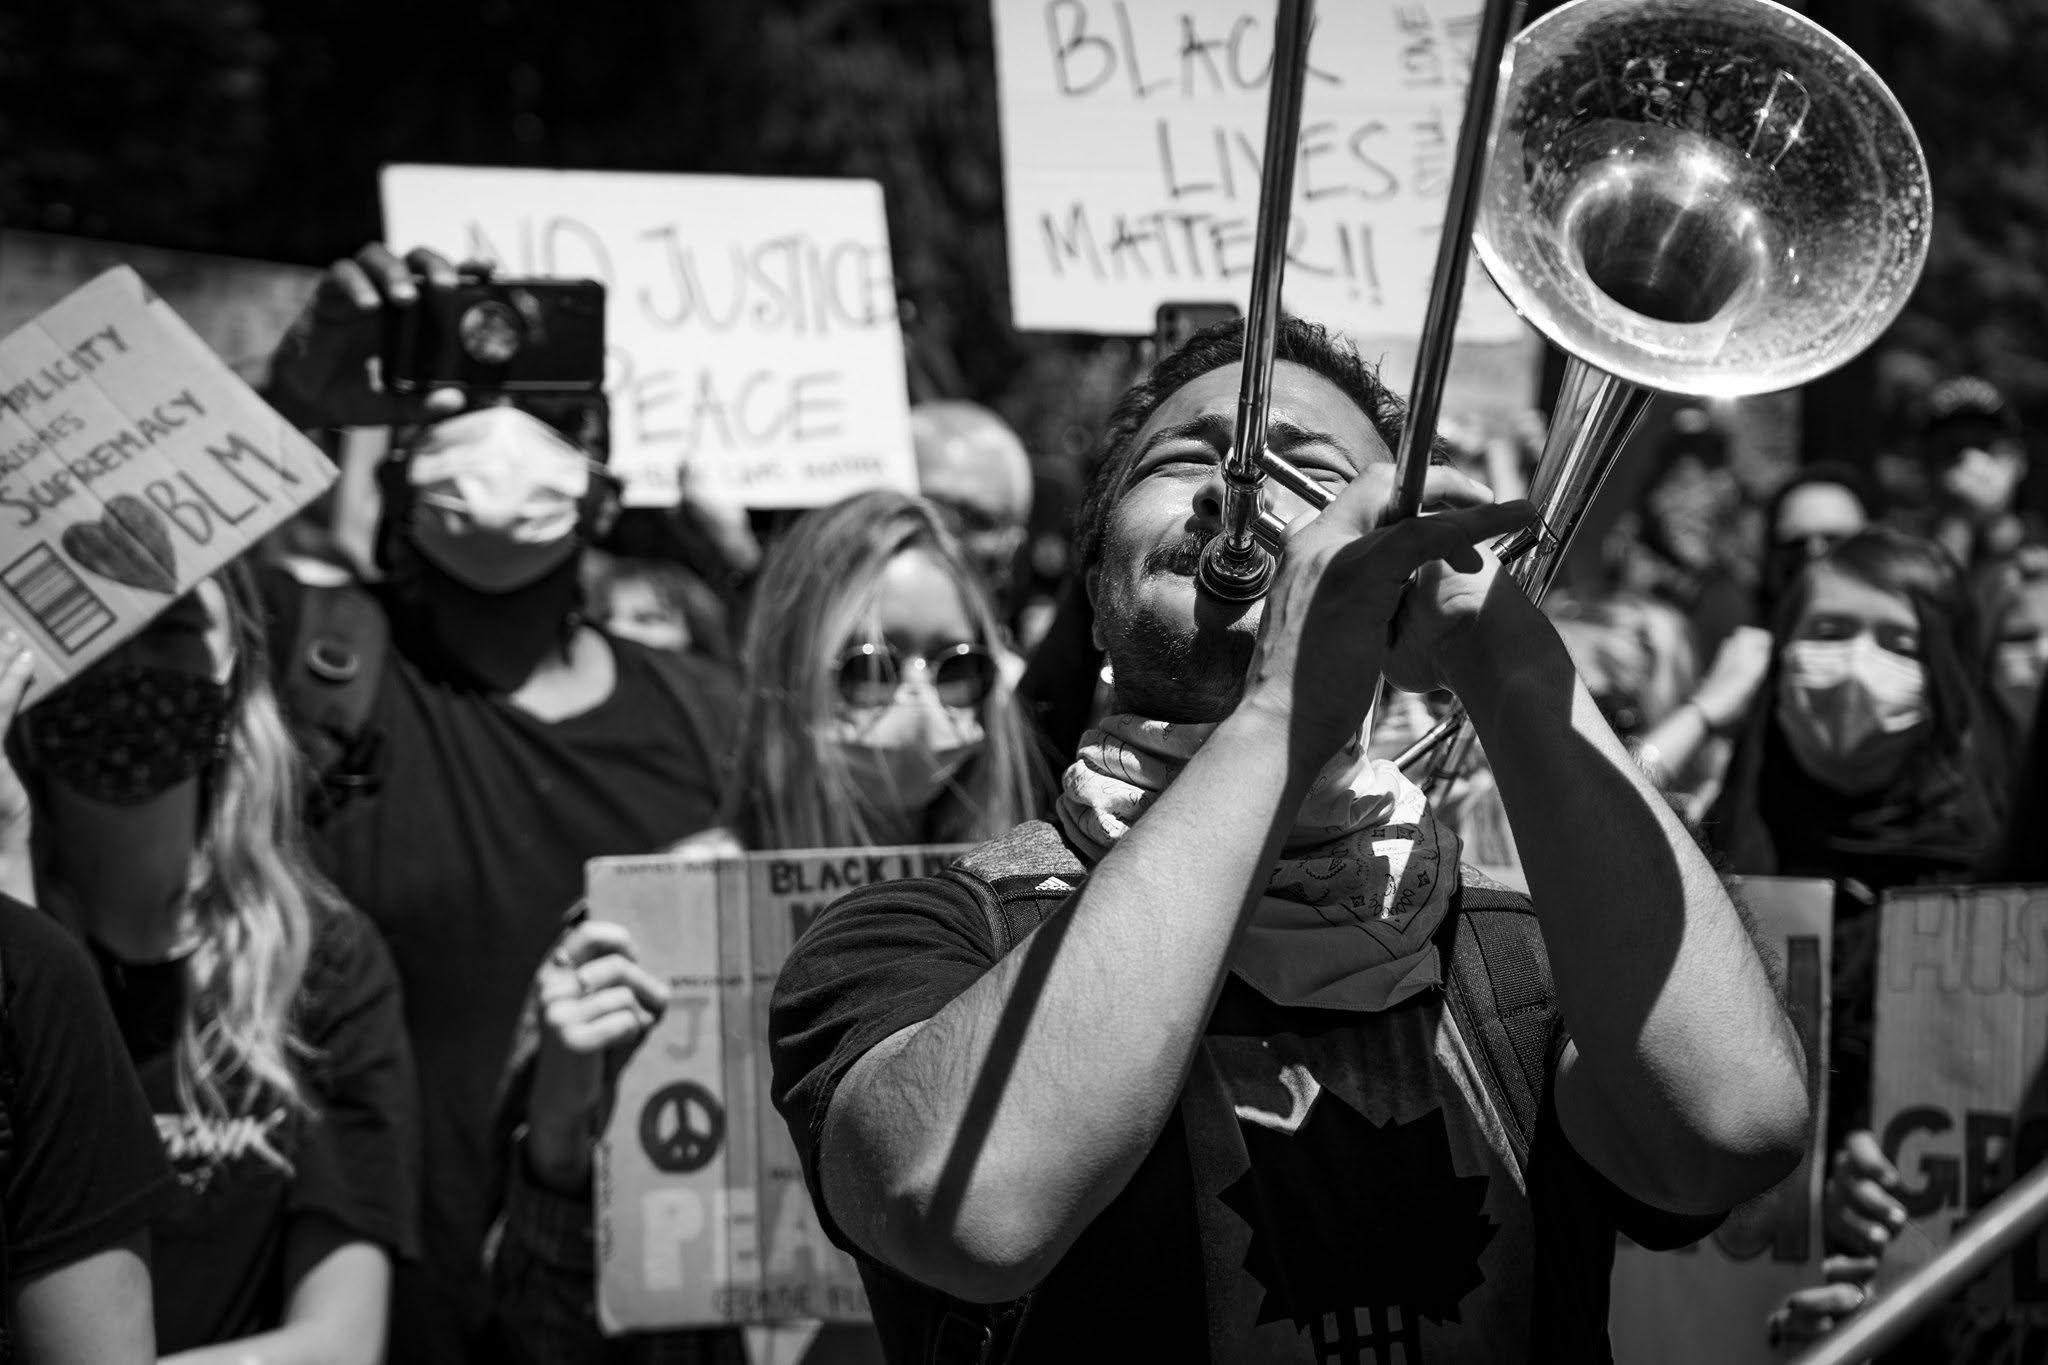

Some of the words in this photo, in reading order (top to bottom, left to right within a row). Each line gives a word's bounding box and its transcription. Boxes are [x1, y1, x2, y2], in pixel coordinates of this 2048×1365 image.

[635, 224, 901, 332] JUSTICE
[0, 389, 207, 528] SUPREMACY
[145, 433, 304, 546] BLM
[769, 855, 886, 894] BLACK
